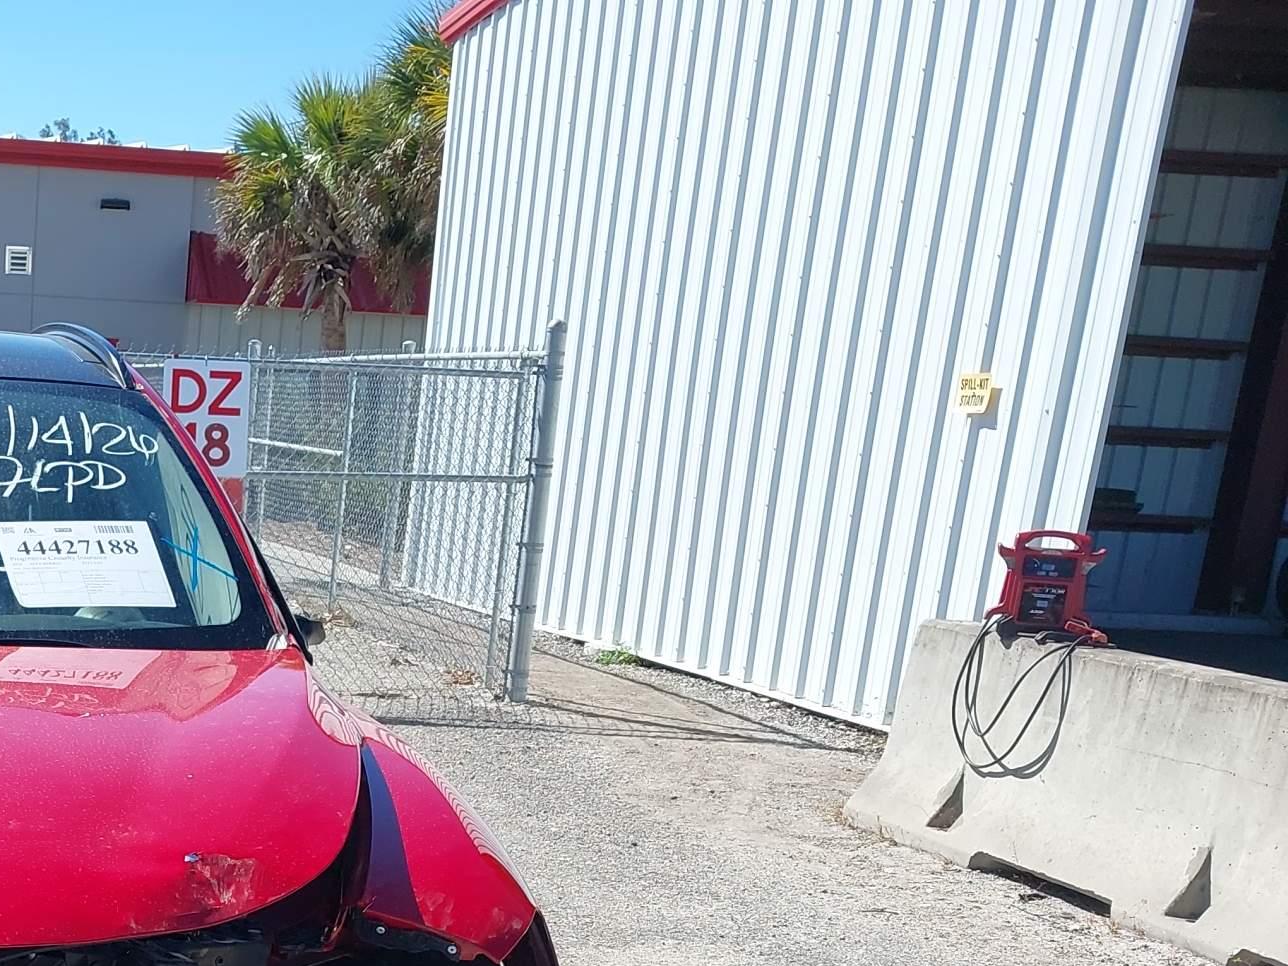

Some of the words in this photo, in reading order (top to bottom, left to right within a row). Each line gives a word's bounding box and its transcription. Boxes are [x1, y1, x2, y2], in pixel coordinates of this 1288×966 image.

[170, 368, 243, 416] DZ
[960, 377, 990, 391] SPILL-KIT
[959, 394, 985, 407] STATION
[17, 538, 140, 556] 44427188
